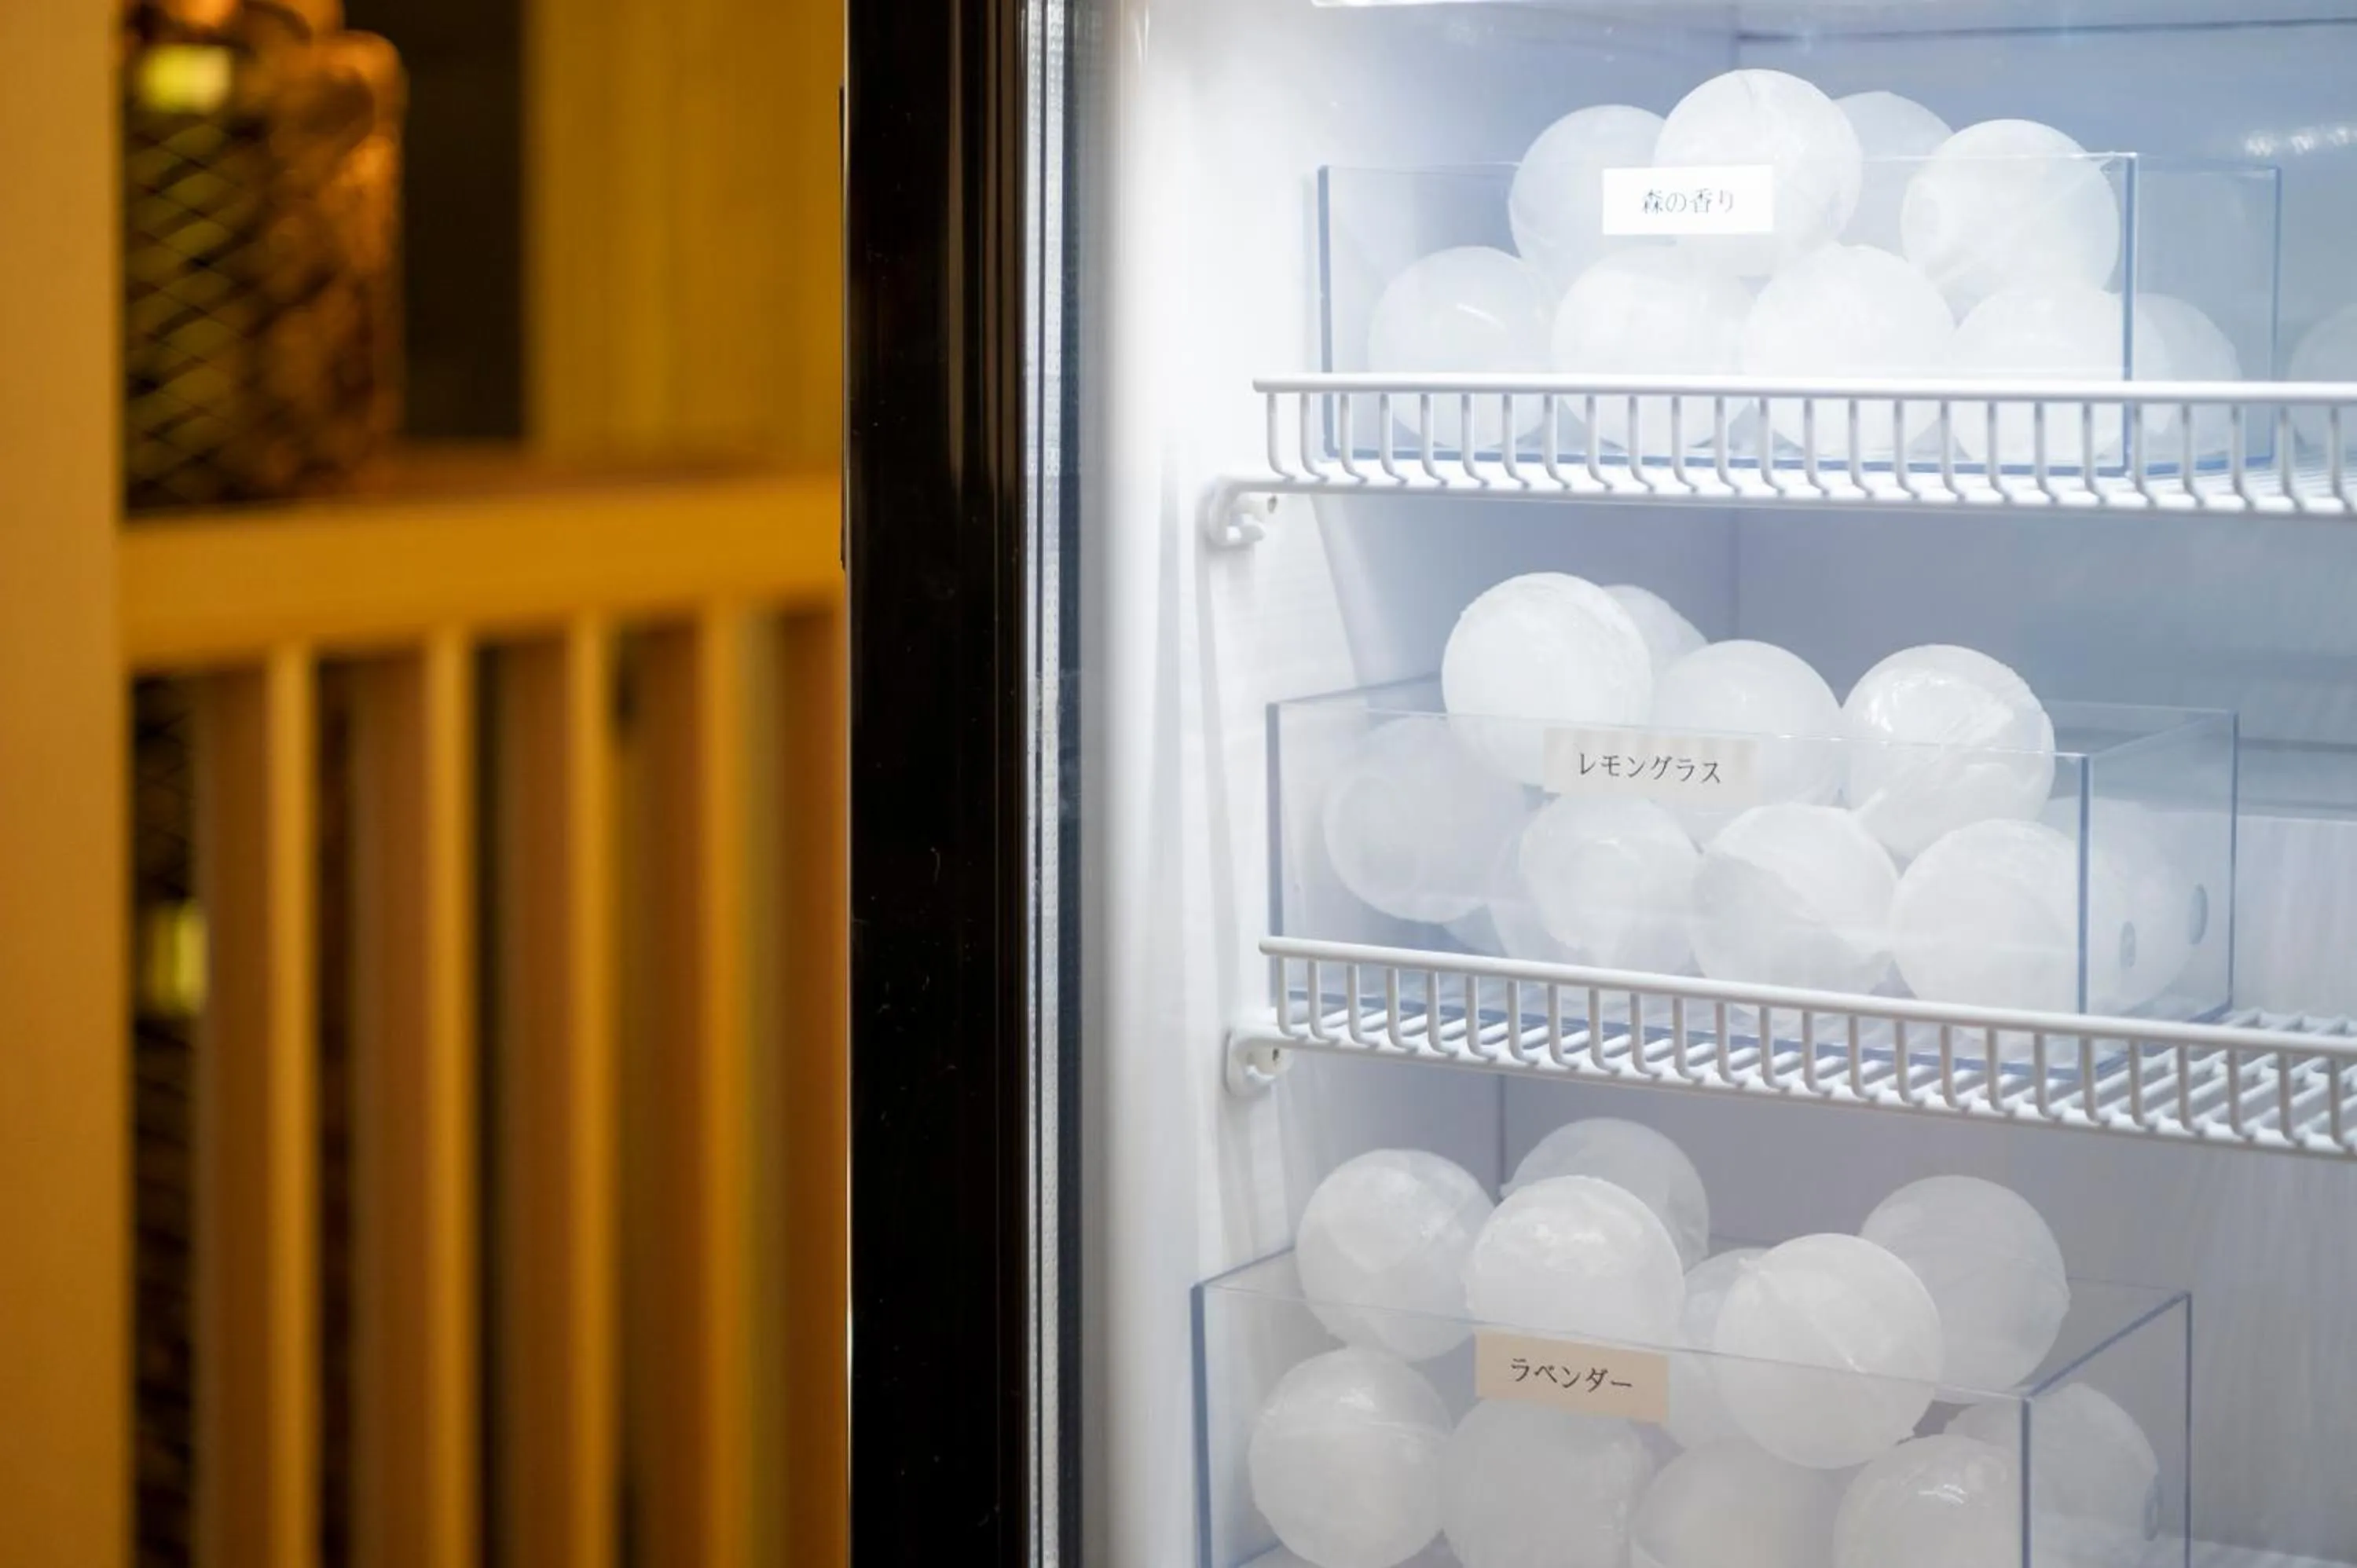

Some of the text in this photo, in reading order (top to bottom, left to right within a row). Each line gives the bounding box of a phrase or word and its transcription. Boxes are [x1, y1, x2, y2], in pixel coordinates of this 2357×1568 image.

[1640, 188, 1734, 214] 森の香り
[1579, 752, 1721, 784] レモングラス
[1510, 1357, 1633, 1393] ラベンダー
